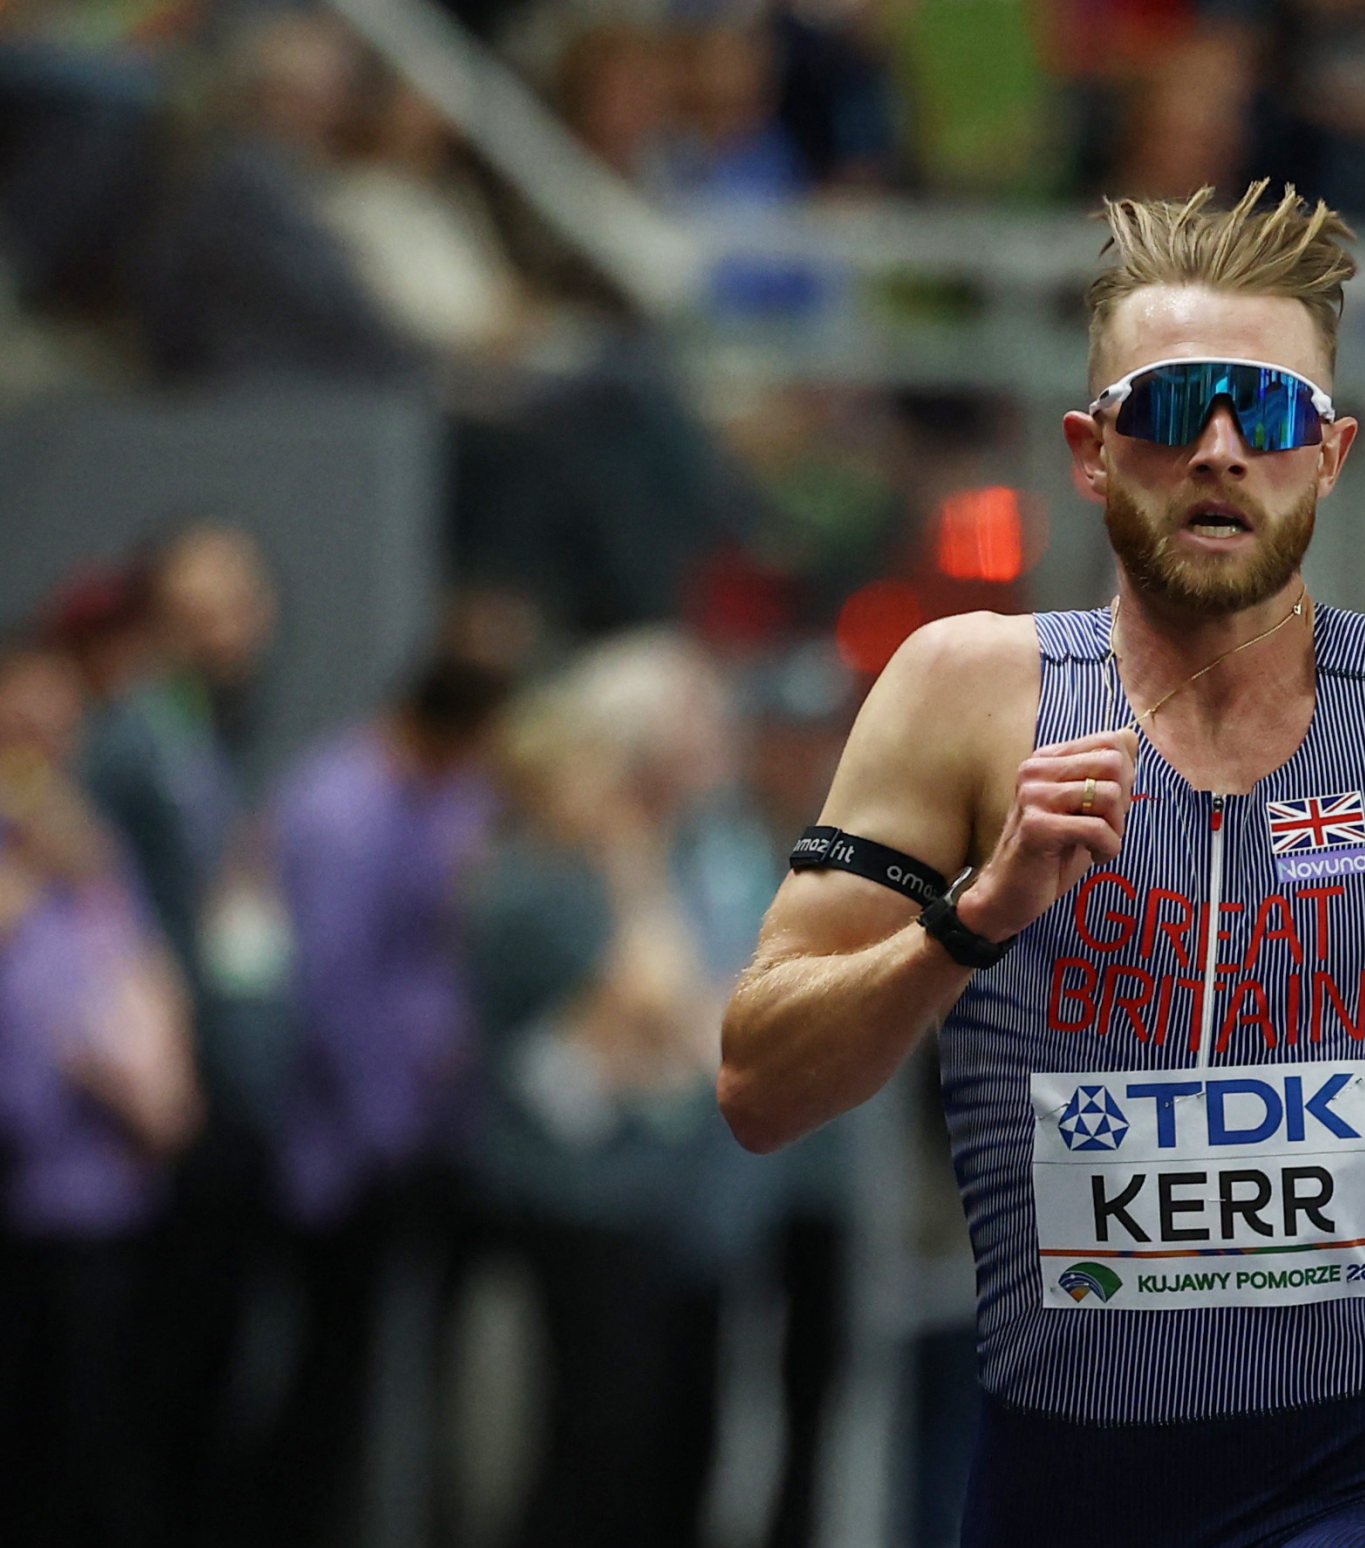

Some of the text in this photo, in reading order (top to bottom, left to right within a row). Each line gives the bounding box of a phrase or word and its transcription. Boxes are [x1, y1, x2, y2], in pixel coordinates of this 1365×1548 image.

[1075, 871, 1344, 974] GREAT
[1126, 1072, 1362, 1148] TDK
[1091, 1166, 1336, 1242] KERR
[1138, 1271, 1231, 1293] KUJAWY
[1236, 1264, 1341, 1289] POMORZE
